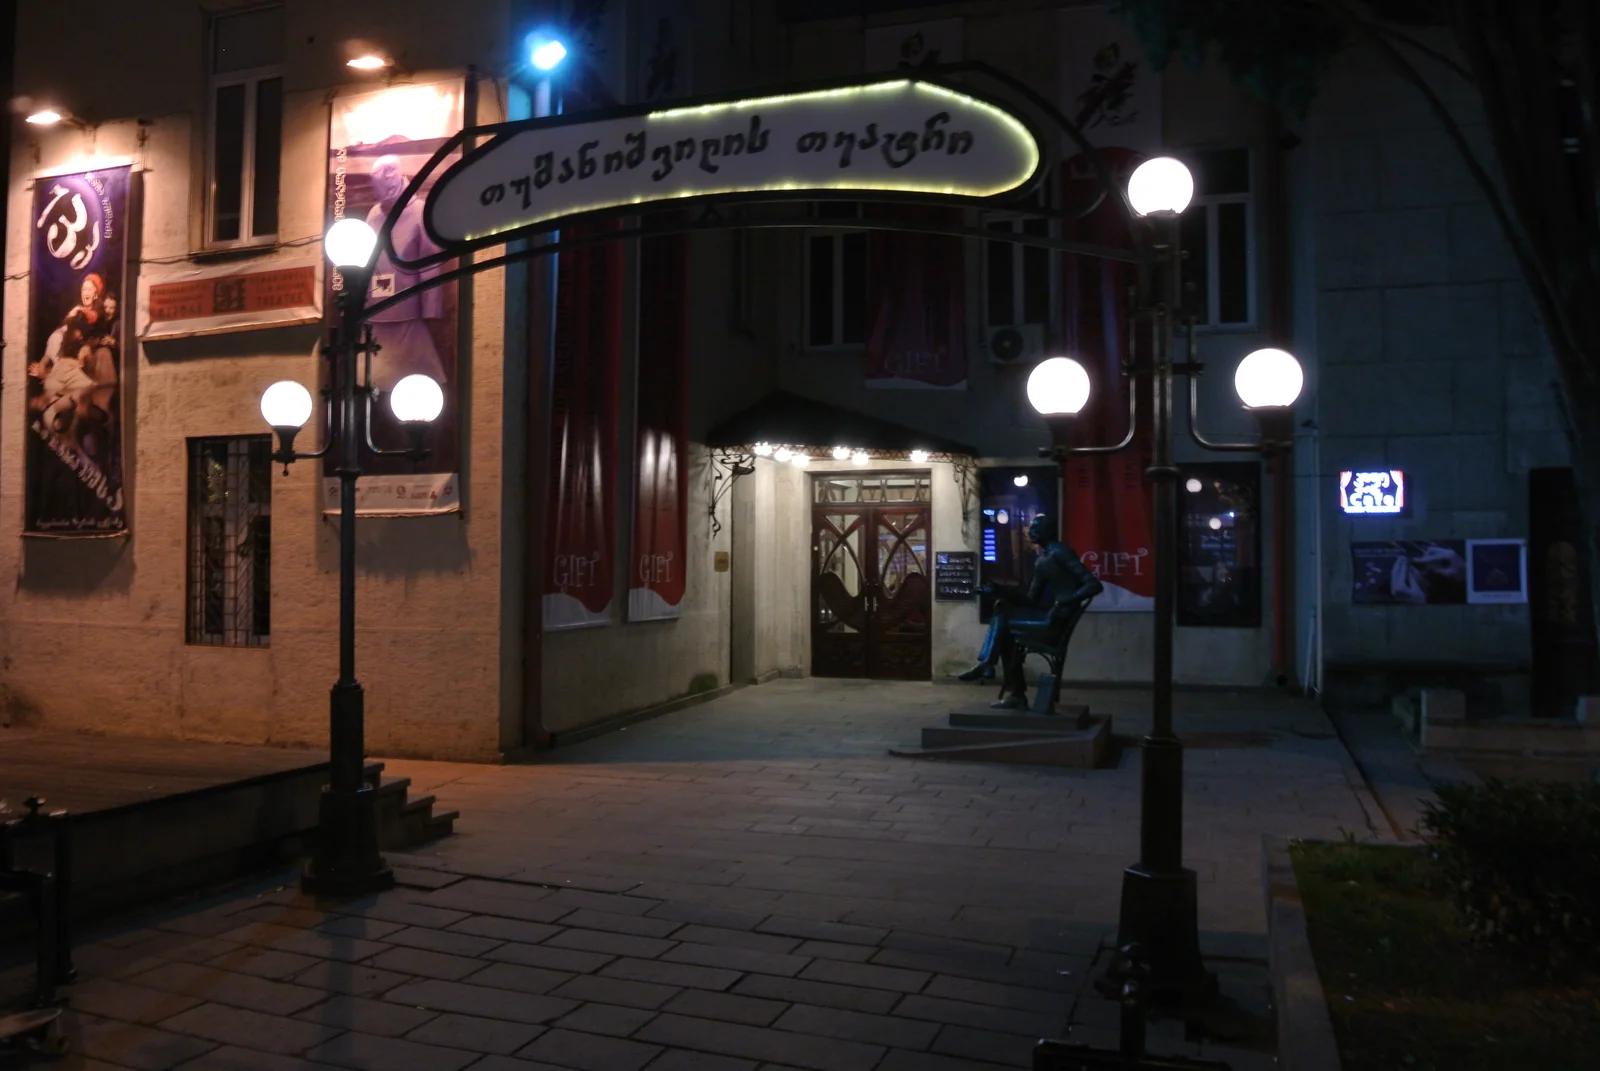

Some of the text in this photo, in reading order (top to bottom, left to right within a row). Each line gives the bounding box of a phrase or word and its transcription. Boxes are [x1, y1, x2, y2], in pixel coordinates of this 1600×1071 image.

[479, 115, 770, 209] თუმანიშვილის
[884, 345, 946, 376] GIFT
[552, 551, 600, 592] GIFT
[639, 551, 674, 588] GIFT
[1079, 547, 1149, 578] GIFT
